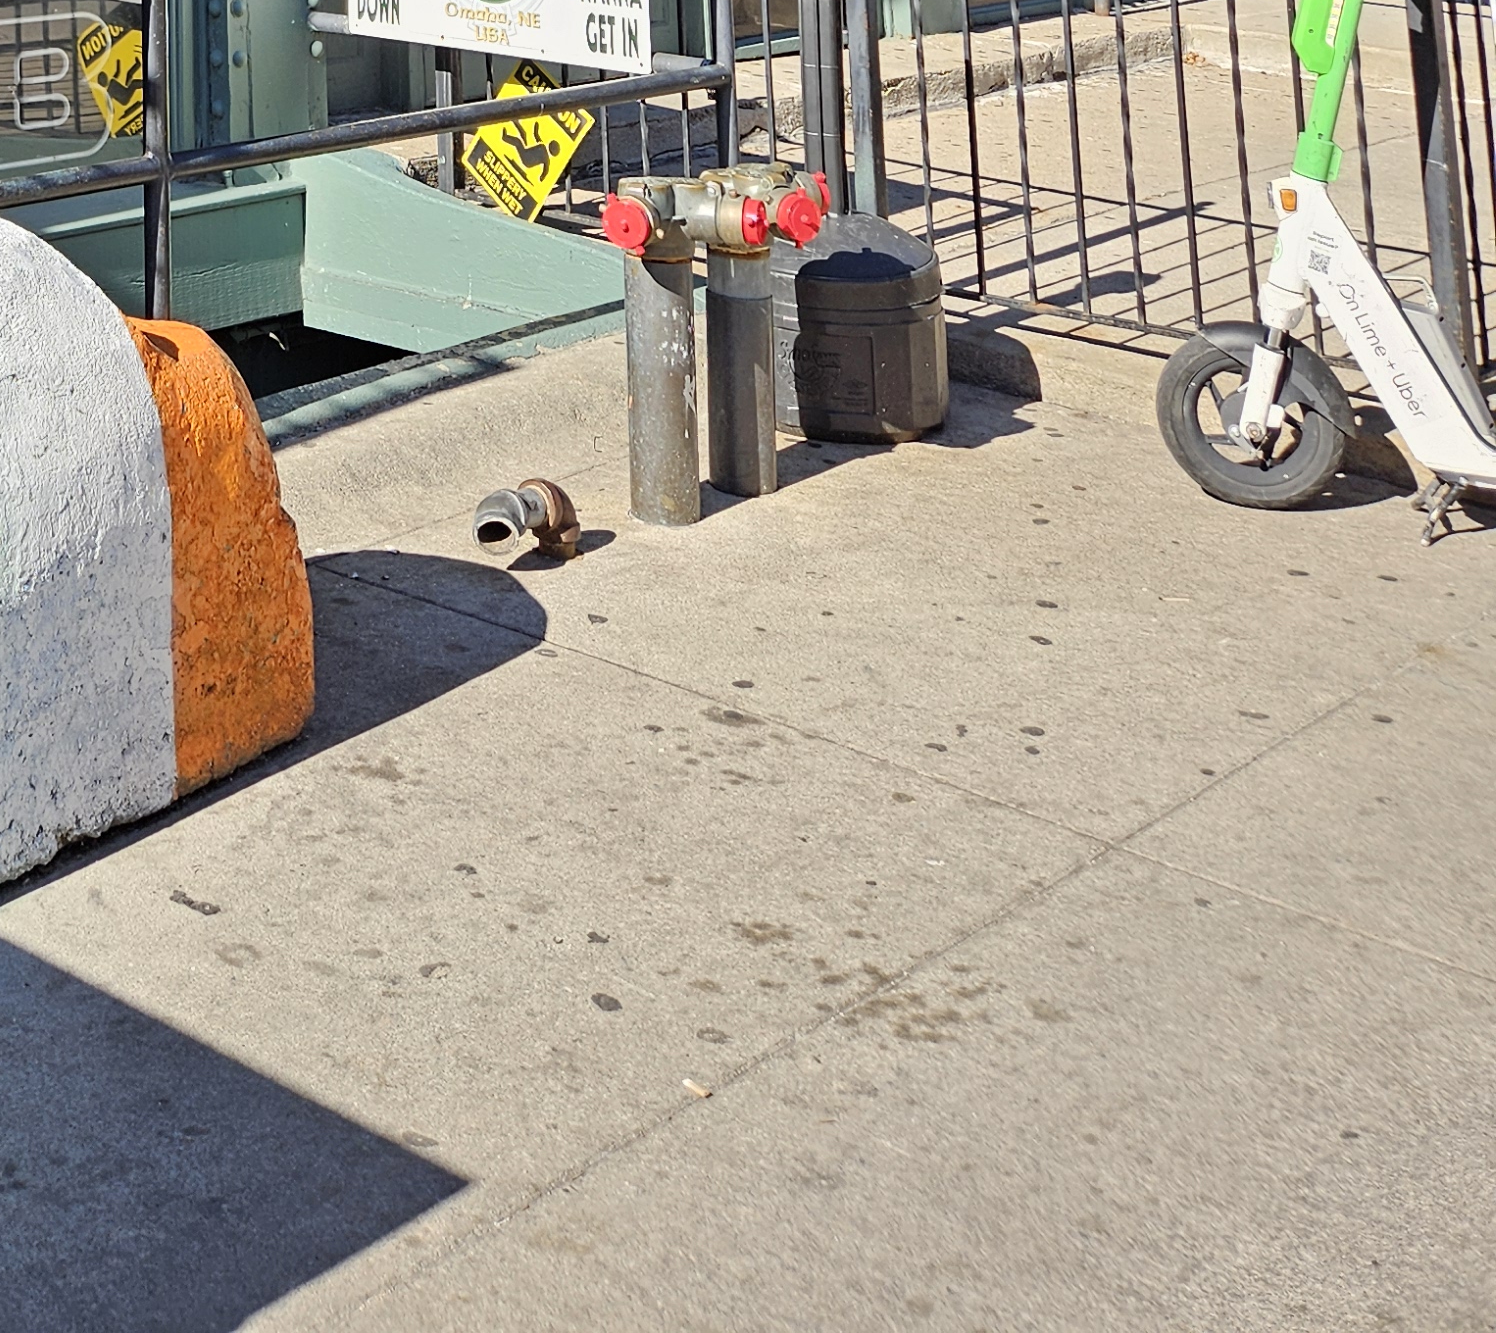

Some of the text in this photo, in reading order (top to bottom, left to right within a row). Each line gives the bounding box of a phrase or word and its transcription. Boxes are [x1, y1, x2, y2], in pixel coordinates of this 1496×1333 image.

[444, 1, 541, 29] Omaha, NE
[475, 25, 510, 46] USA
[586, 12, 640, 59] GET IN
[521, 65, 582, 134] CAON
[476, 157, 524, 215] WHEN WET
[484, 150, 527, 201] SLIPPERY
[1338, 282, 1360, 312] On
[1354, 312, 1388, 358] Lime
[1392, 372, 1427, 420] Uber
